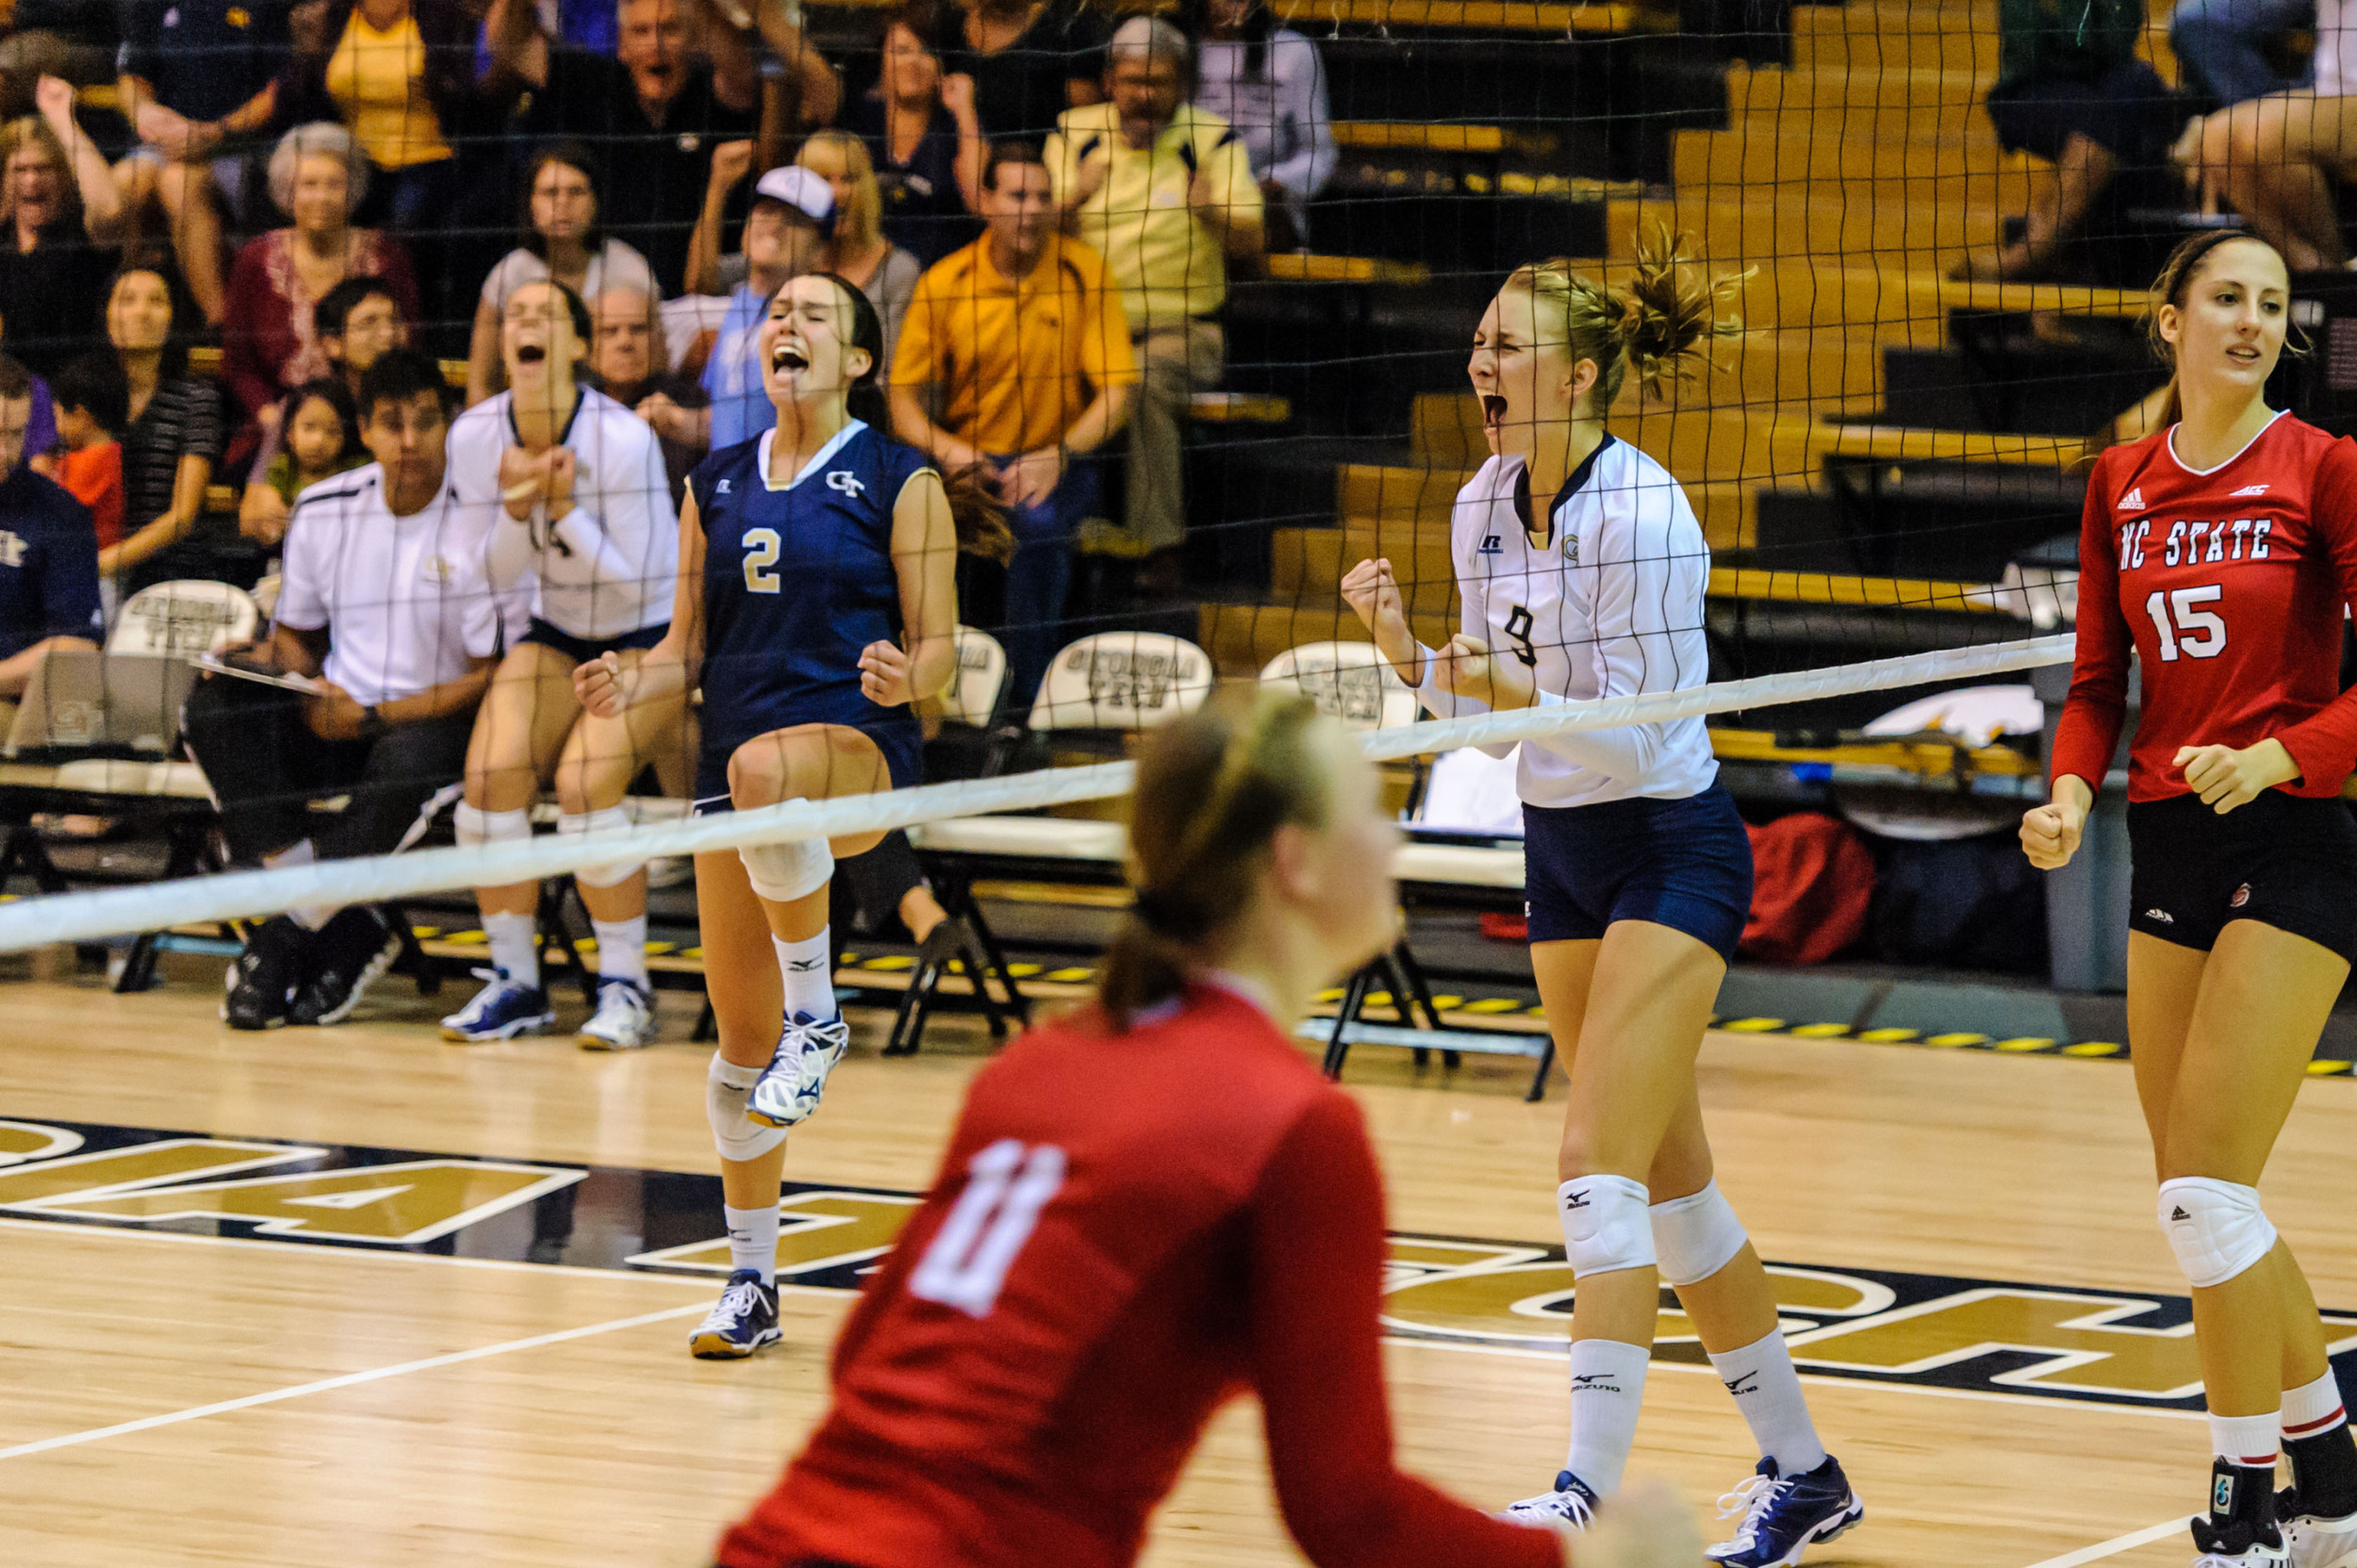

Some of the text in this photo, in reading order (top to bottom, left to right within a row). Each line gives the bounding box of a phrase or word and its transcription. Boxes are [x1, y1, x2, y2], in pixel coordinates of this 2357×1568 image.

[741, 527, 782, 594] 2
[2120, 519, 2272, 570] NC STATE
[2146, 583, 2227, 662] 15
